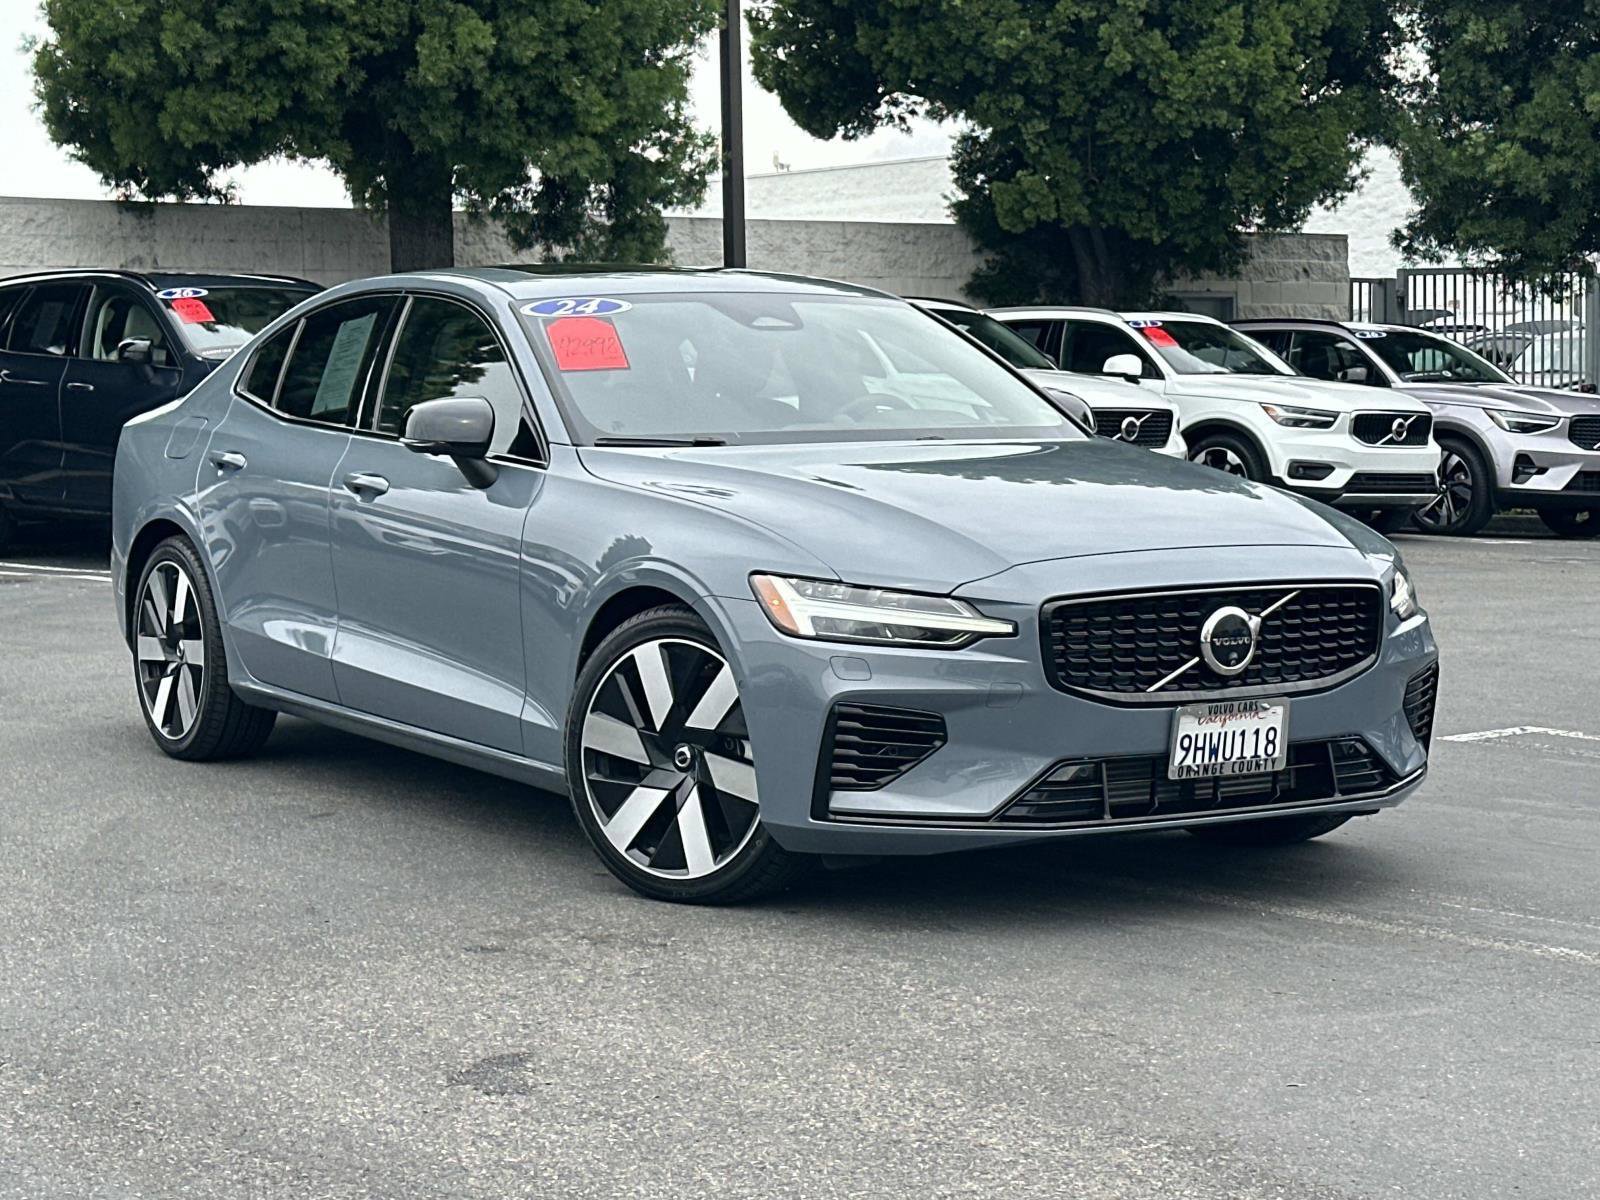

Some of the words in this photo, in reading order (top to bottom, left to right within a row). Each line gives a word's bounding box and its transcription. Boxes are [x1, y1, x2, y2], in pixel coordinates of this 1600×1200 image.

[552, 299, 601, 316] 24
[1212, 636, 1250, 646] VOLVO
[1208, 703, 1234, 716] VOLVO
[1237, 700, 1259, 713] CARS
[1178, 726, 1278, 766] 9HWU118
[1177, 764, 1225, 778] ORANGE
[1231, 757, 1279, 773] COUNTY
